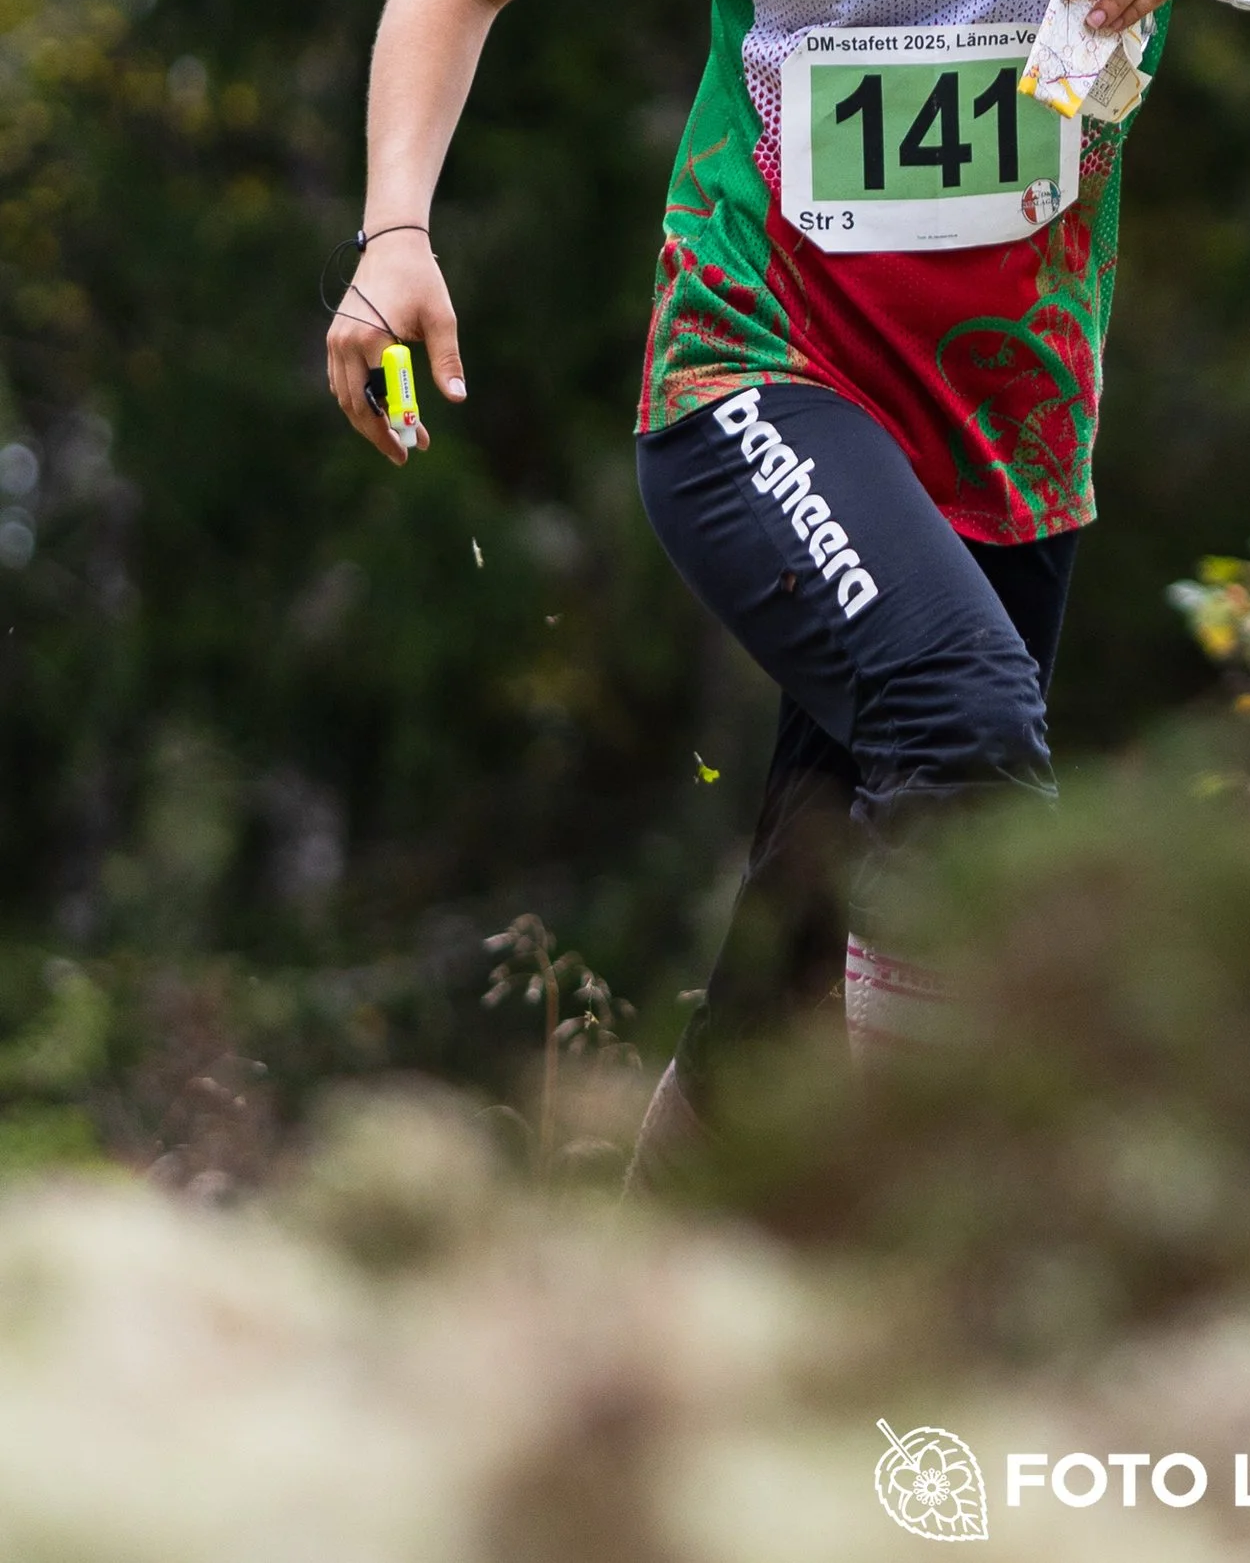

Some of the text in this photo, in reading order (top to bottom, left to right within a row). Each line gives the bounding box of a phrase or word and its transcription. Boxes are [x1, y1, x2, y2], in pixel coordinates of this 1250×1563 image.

[807, 36, 898, 51] DM-stafett
[904, 34, 950, 51] 2025,
[836, 67, 1019, 190] 141
[799, 211, 855, 231] Str 3
[713, 387, 879, 619] bagheera
